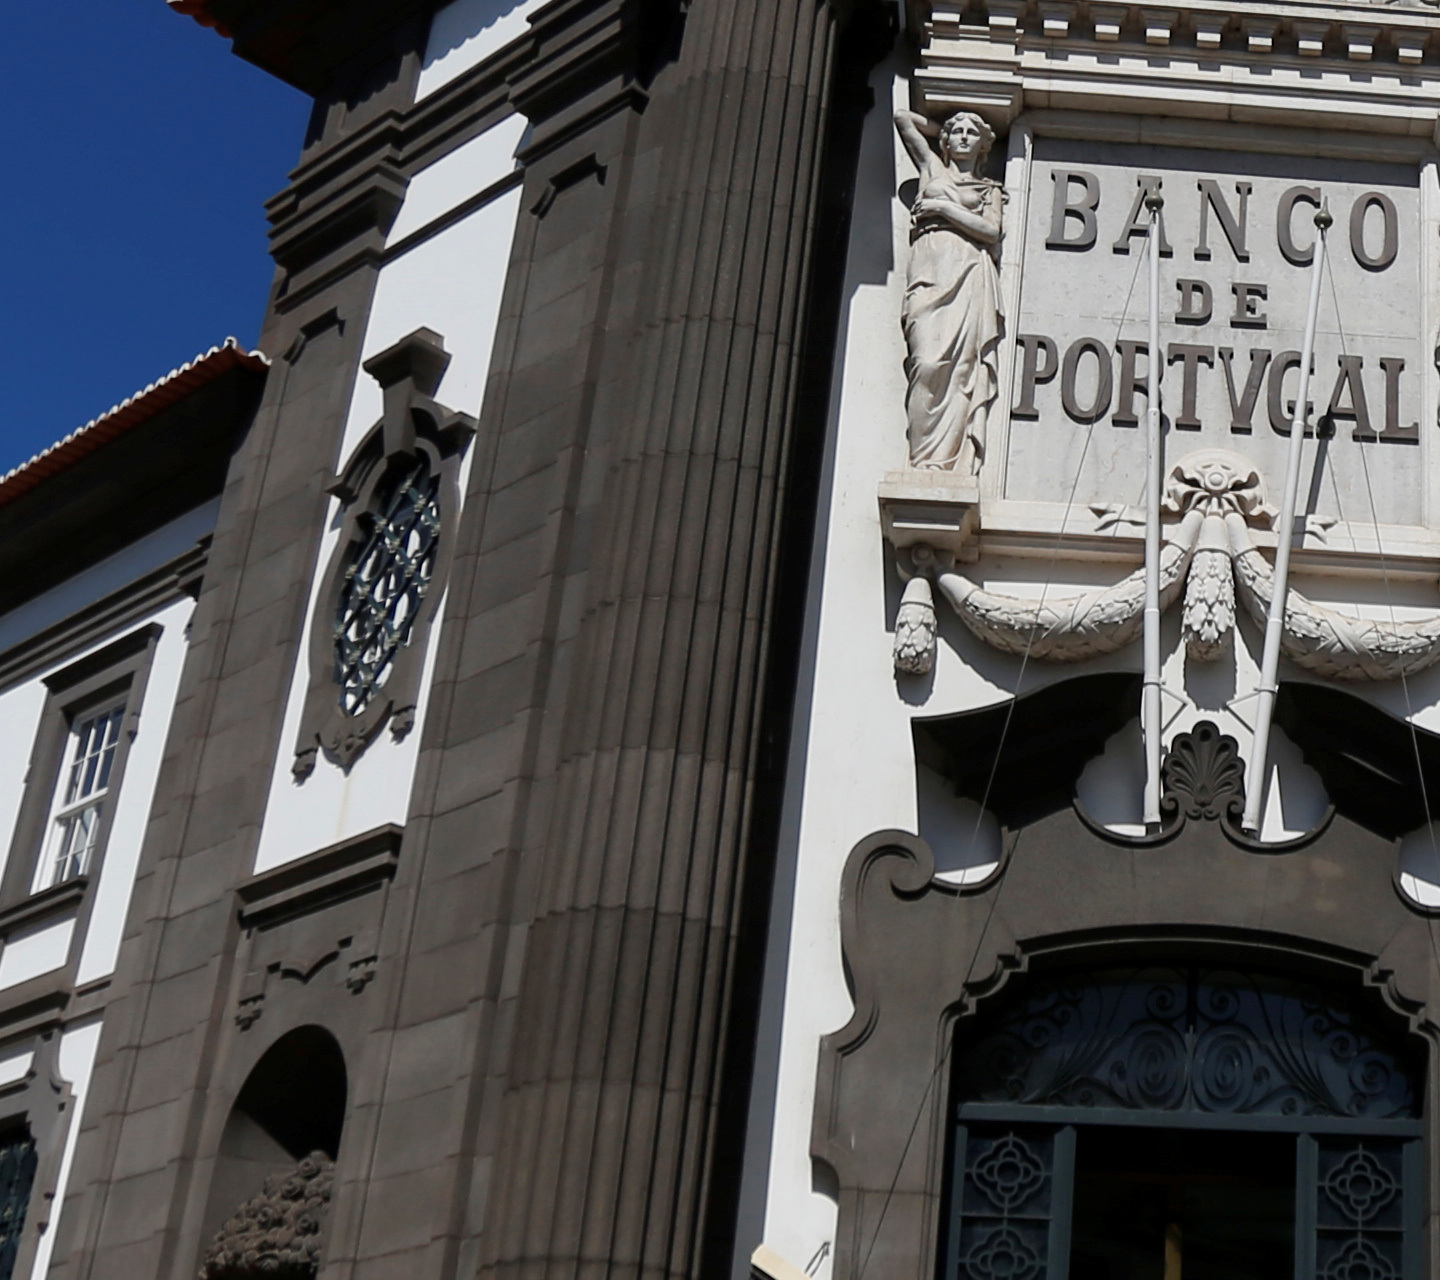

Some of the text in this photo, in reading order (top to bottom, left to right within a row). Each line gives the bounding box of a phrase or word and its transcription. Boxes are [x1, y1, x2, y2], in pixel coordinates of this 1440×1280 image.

[1044, 168, 1399, 273] BANCO
[1174, 277, 1268, 330] DE
[1010, 333, 1419, 445] PORTVGAL
